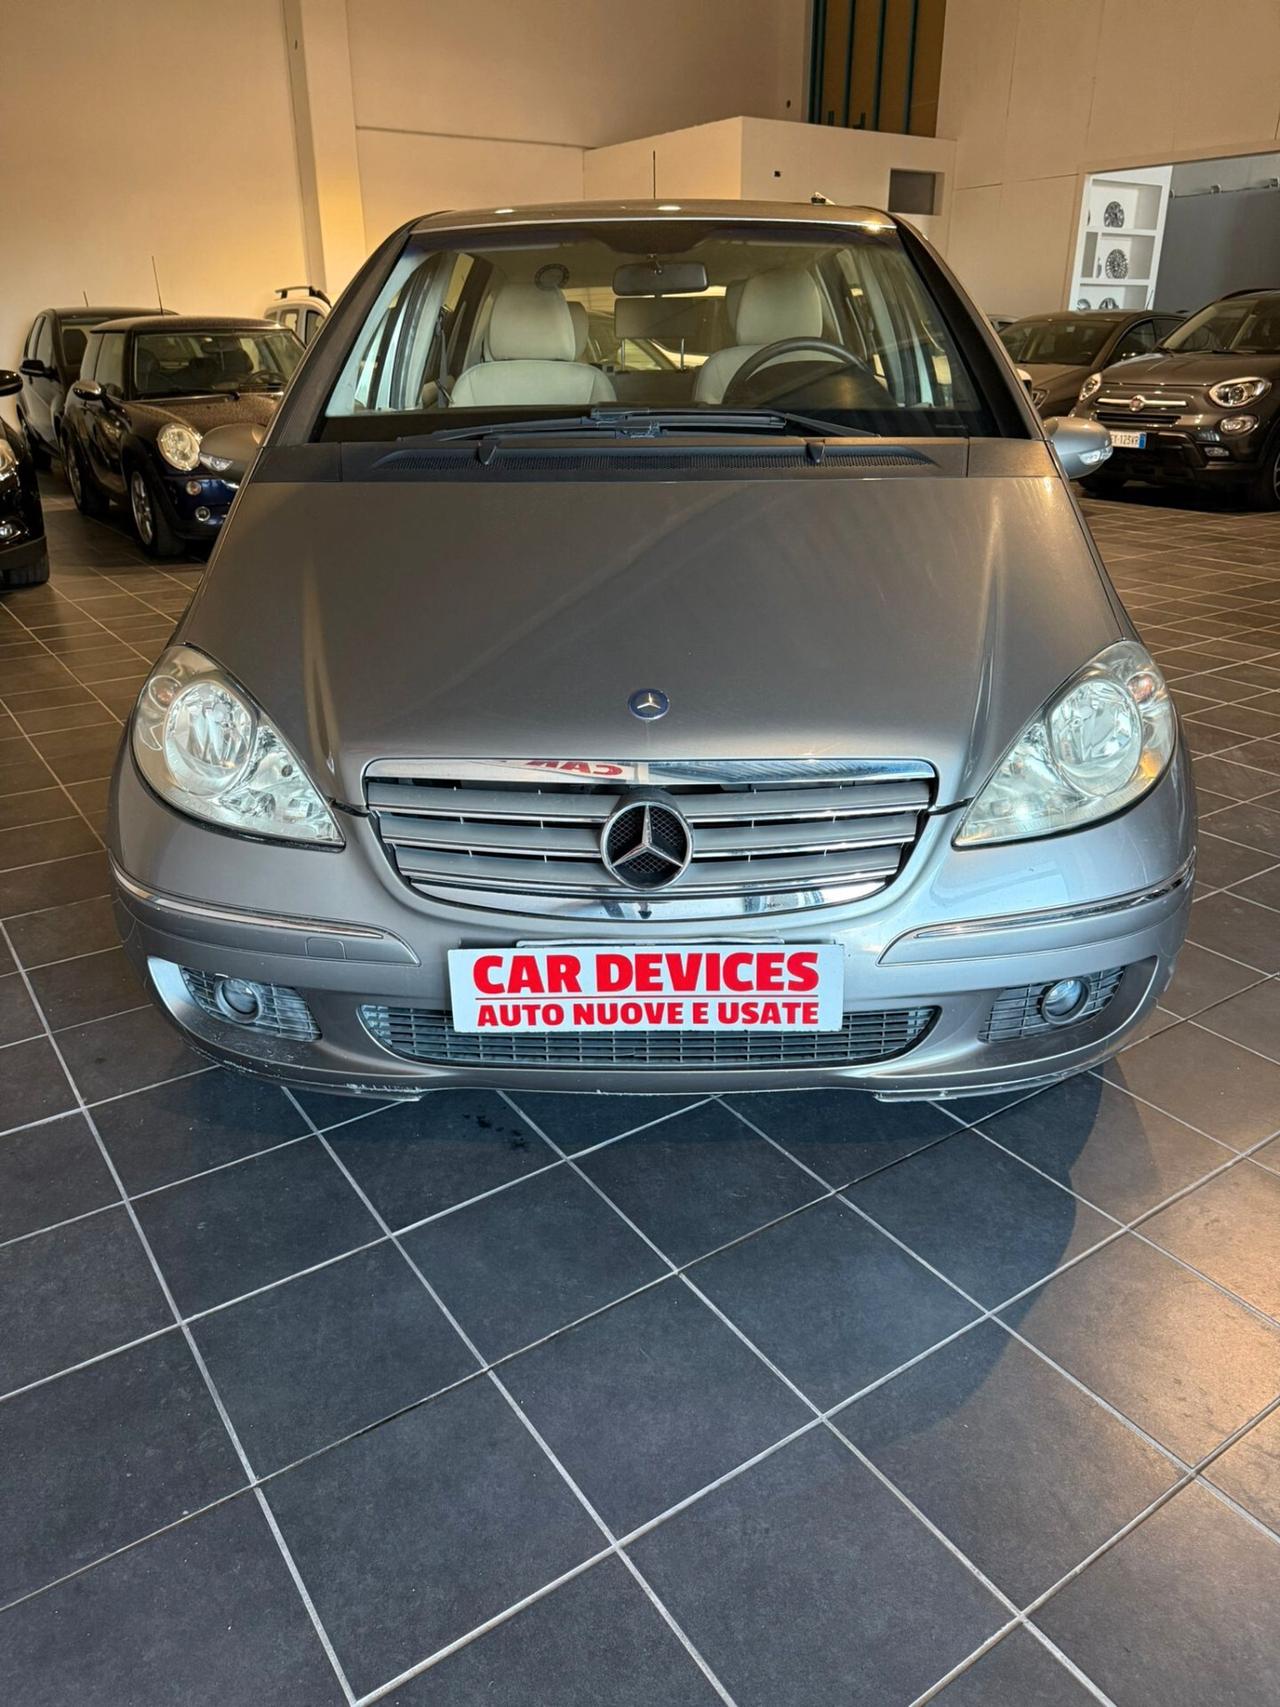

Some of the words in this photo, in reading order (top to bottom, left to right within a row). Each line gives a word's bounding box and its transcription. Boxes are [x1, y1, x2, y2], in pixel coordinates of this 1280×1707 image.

[473, 954, 582, 994] CAR
[595, 951, 820, 993] DEVICES
[477, 1003, 565, 1027] AUTO
[573, 1002, 684, 1025] NUOVE
[692, 1002, 709, 1025] E
[717, 1002, 819, 1025] USATE
